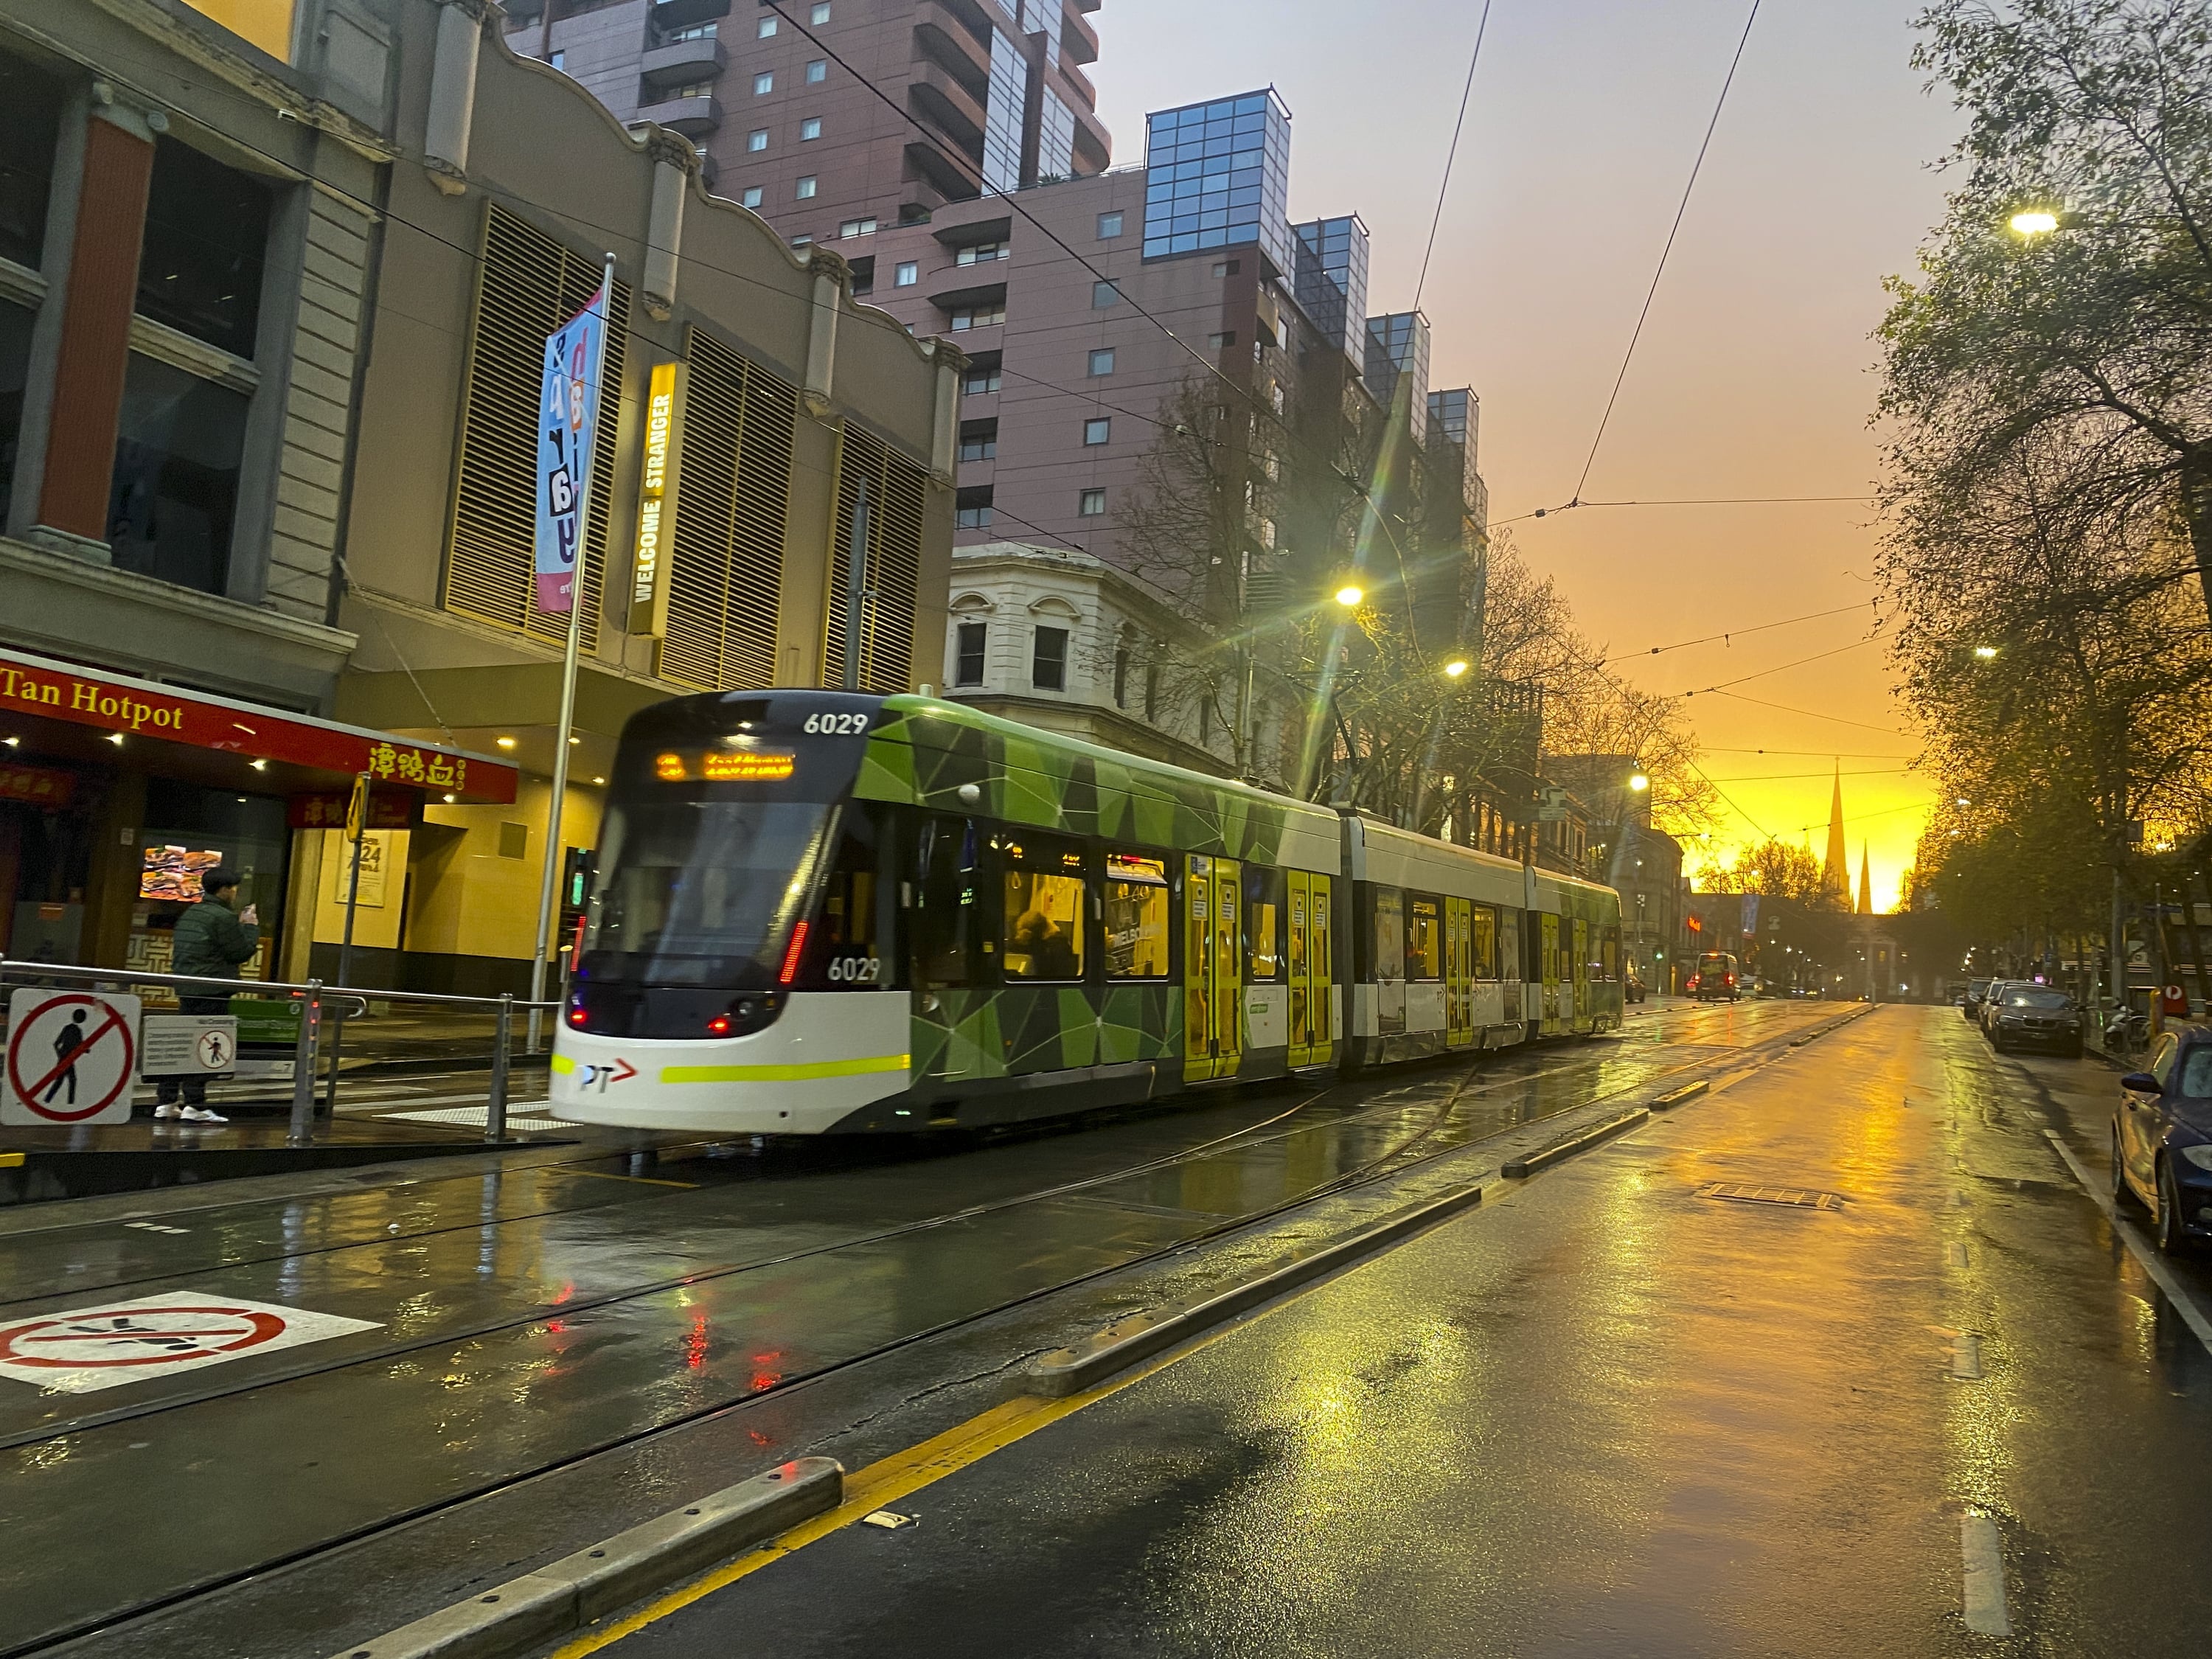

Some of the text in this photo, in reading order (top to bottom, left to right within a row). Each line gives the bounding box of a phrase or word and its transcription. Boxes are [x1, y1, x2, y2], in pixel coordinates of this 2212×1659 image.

[634, 392, 671, 603] WELCOME STRANGER
[0, 667, 184, 730] Tan Hotpot
[804, 713, 869, 735] 6029
[827, 957, 881, 981] 6029
